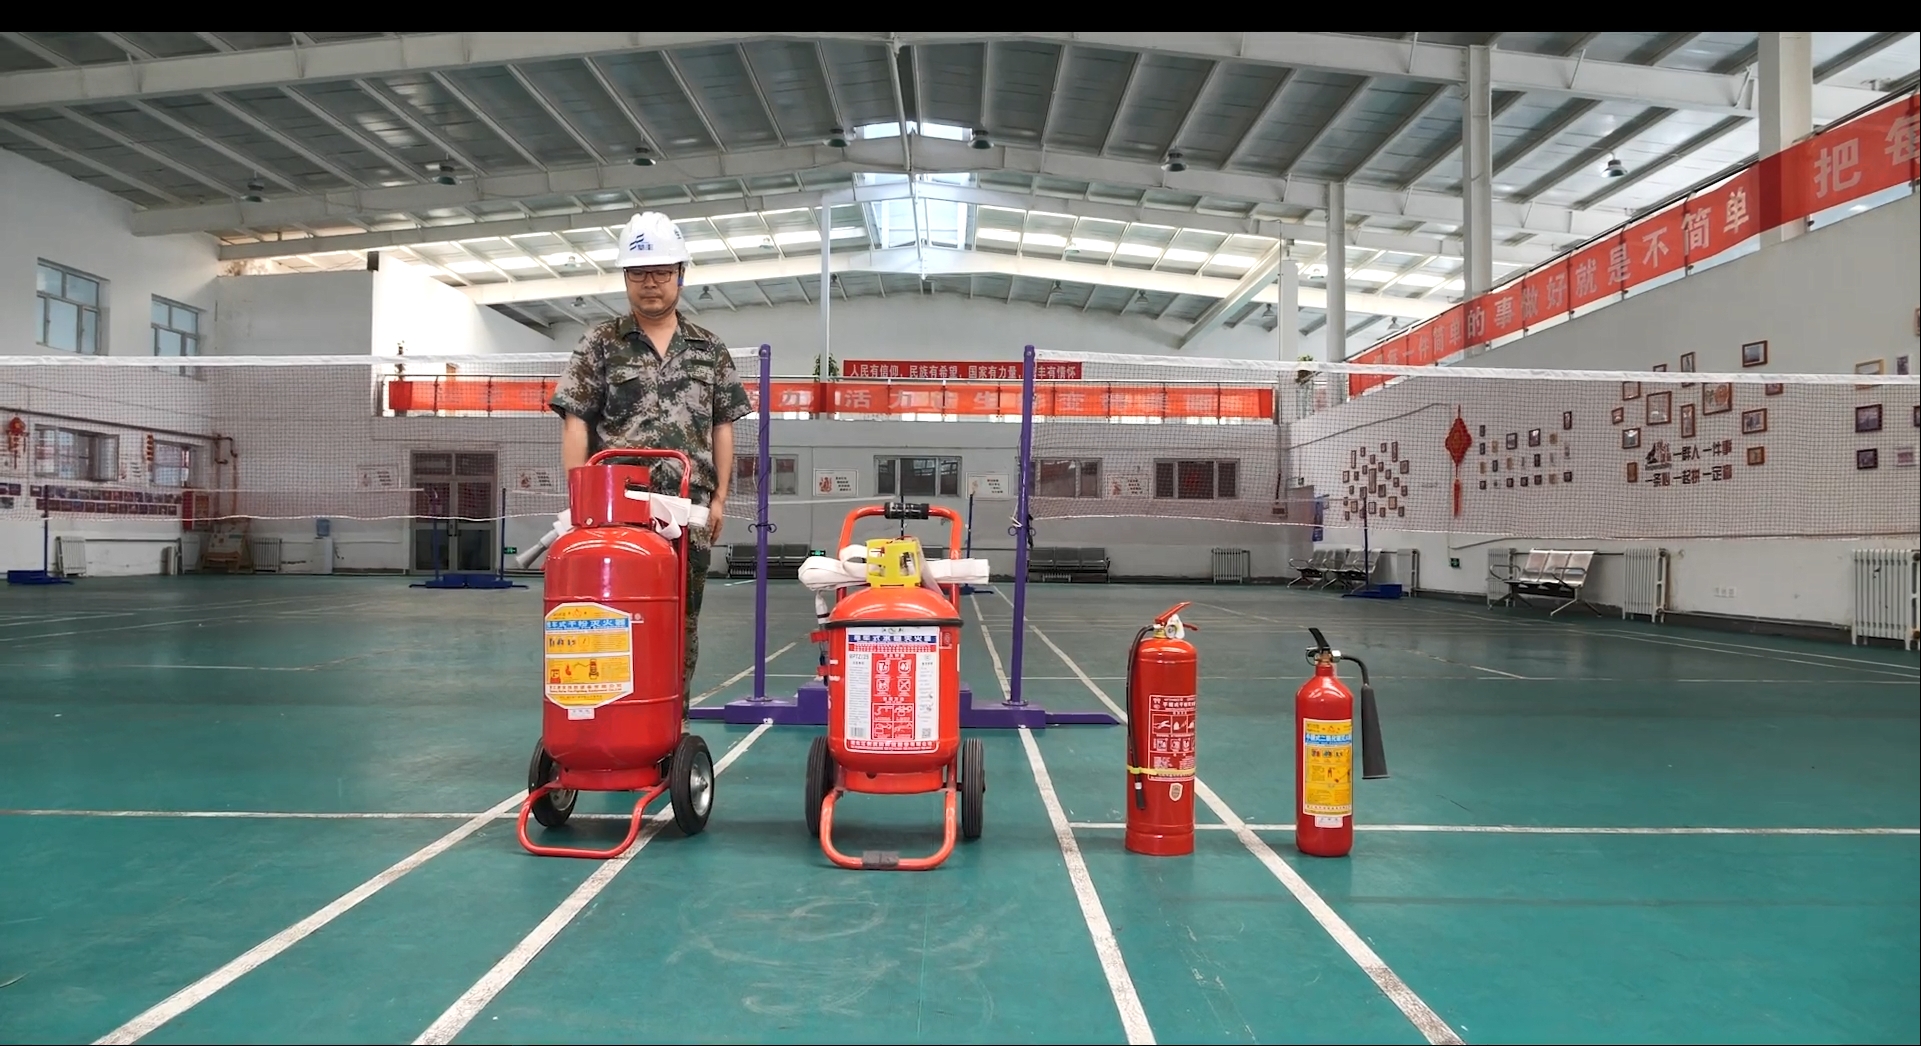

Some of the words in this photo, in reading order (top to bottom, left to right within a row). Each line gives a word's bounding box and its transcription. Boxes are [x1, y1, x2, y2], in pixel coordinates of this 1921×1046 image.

[850, 363, 1076, 379] 人民有信仰，民族有希望，国家有力量，丰有情怀
